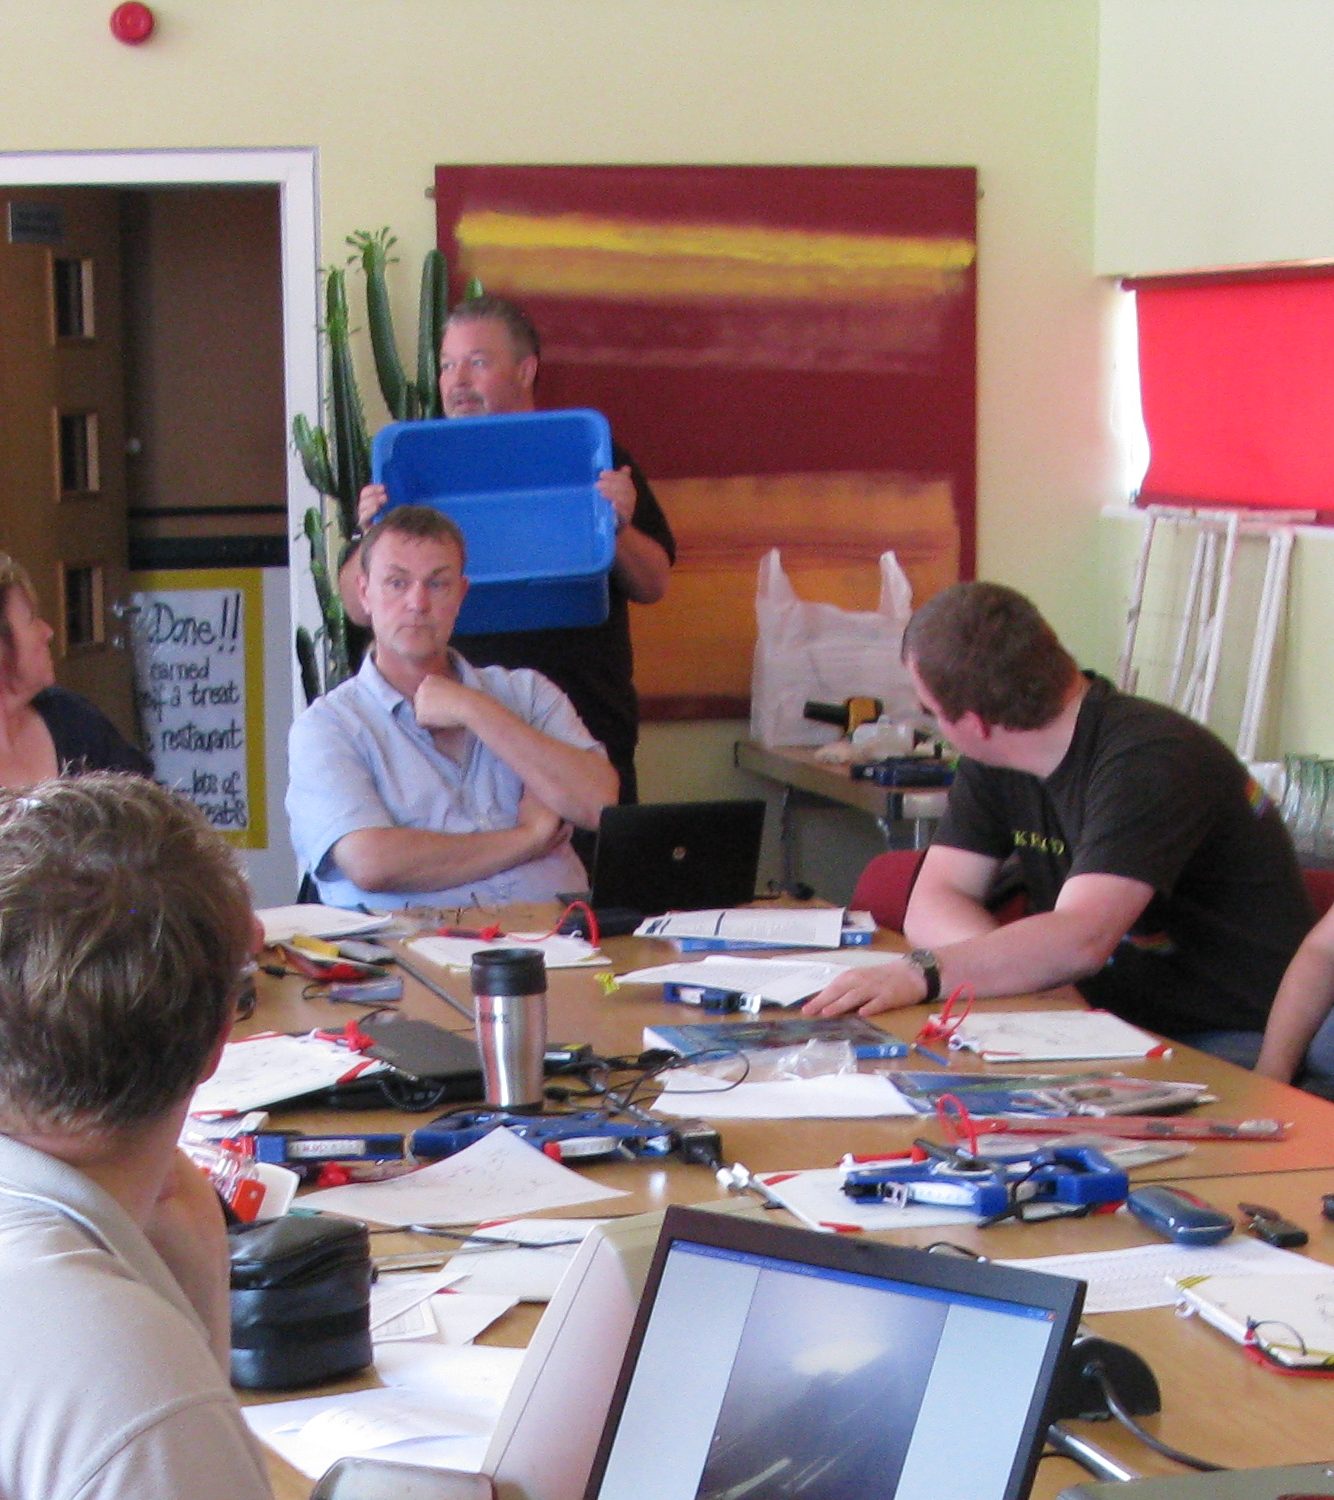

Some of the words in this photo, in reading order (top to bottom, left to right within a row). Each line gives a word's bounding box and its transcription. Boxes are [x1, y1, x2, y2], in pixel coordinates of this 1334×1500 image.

[150, 657, 210, 680] earned
[188, 681, 241, 706] treat
[161, 718, 243, 754] restaurant
